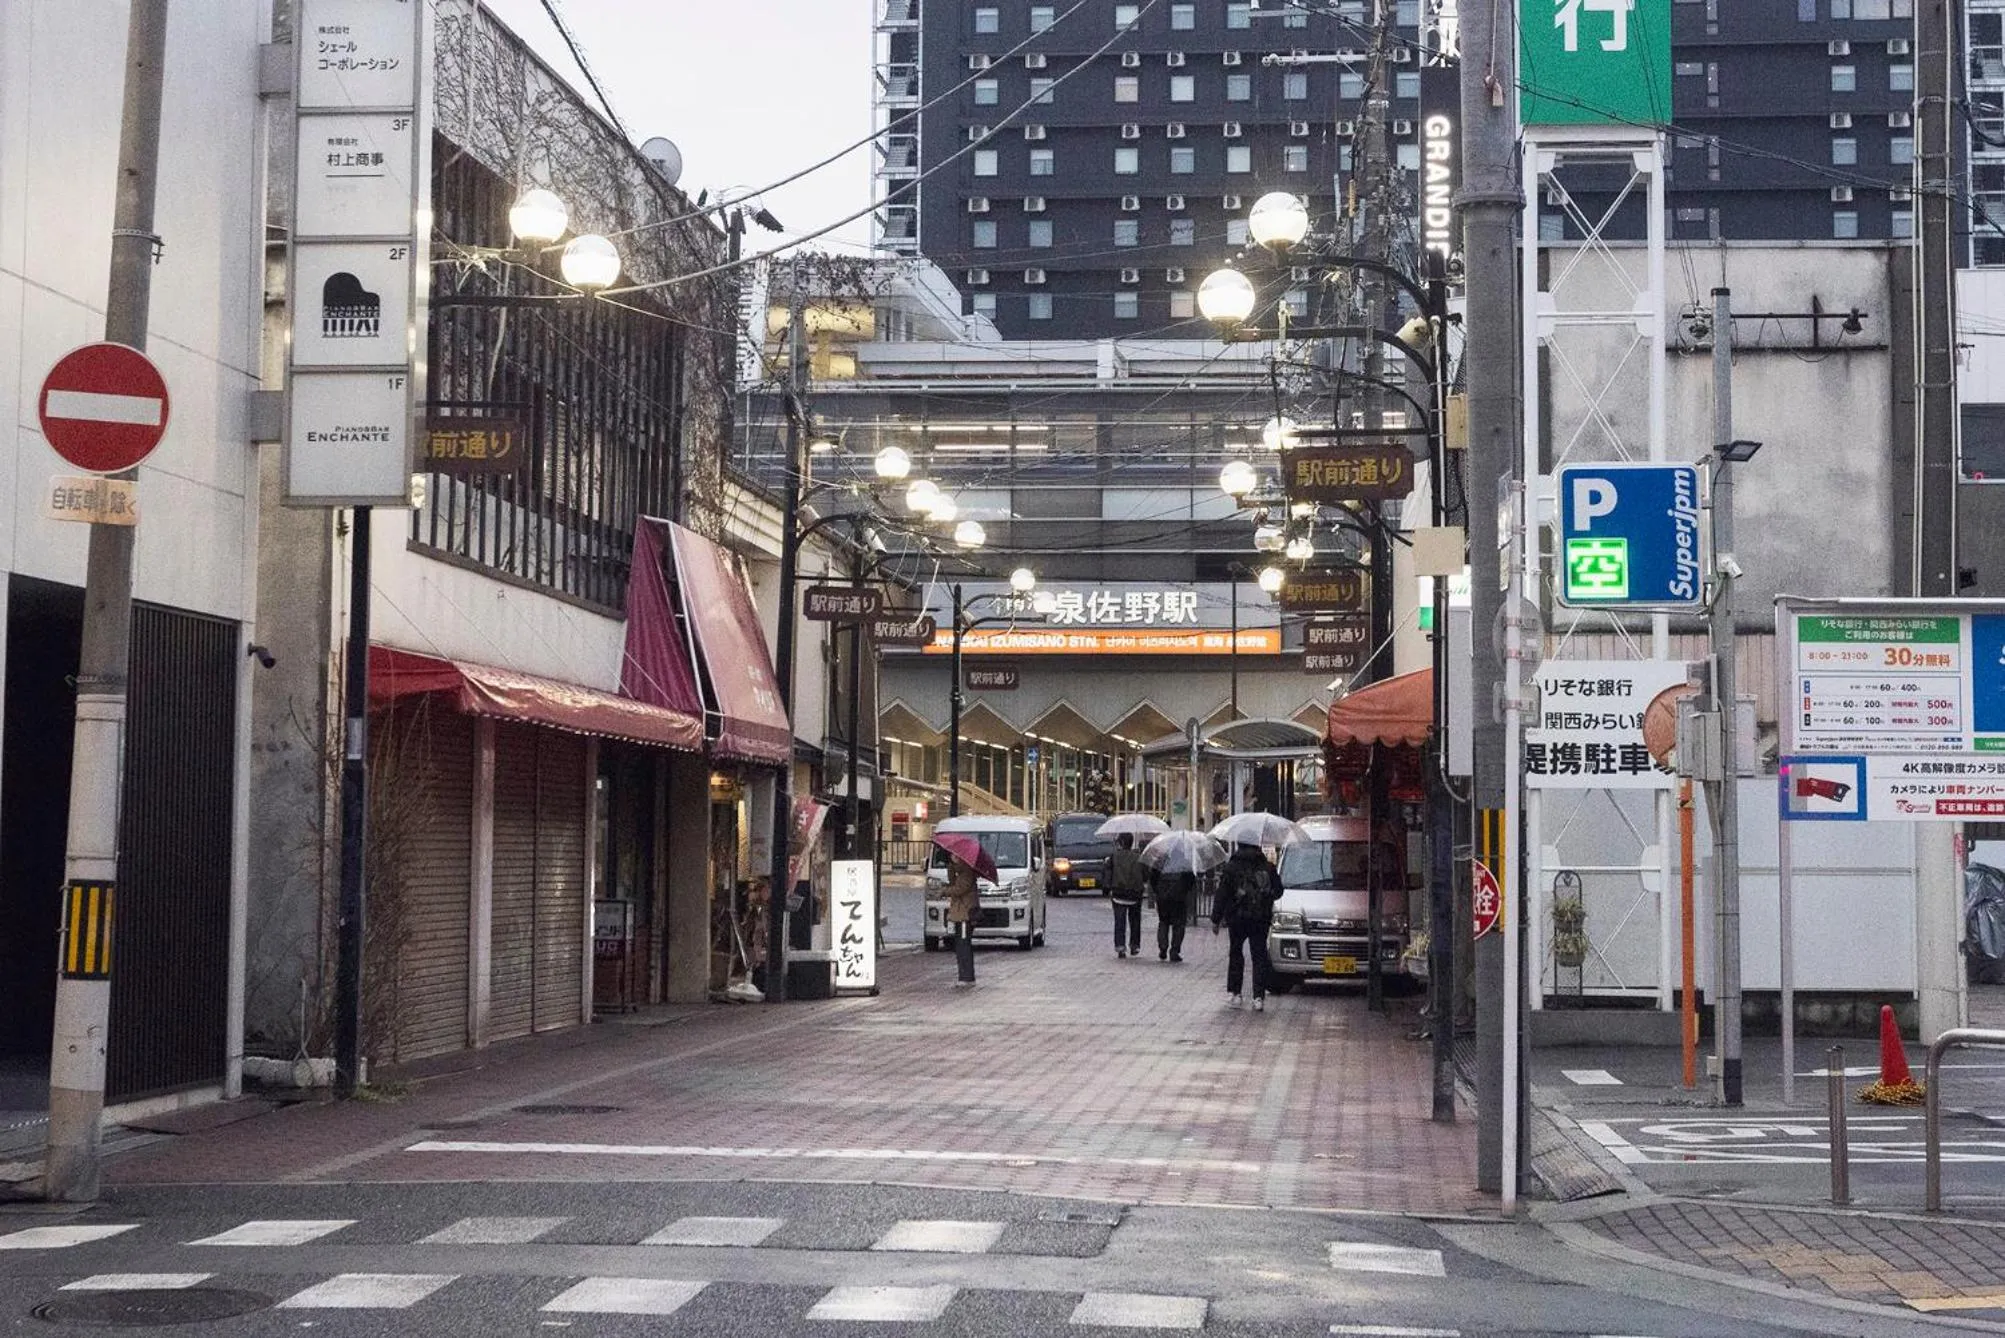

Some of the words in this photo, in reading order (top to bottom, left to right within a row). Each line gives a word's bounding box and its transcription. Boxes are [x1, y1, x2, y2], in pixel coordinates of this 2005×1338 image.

[318, 41, 357, 53] シェール
[318, 57, 399, 70] コーポレーション
[392, 119, 410, 131] 3F
[327, 153, 384, 167] 村上商事
[389, 248, 407, 260] 2F
[388, 378, 405, 390] 1F
[427, 431, 512, 459] 前通り
[1296, 457, 1402, 486] 駅前通り
[1573, 478, 1618, 531] P
[1667, 470, 1698, 599] Superjpm
[1569, 540, 1627, 598] 空
[1286, 584, 1354, 601] 駅前通り
[810, 594, 876, 613] 駅前通り
[1052, 590, 1198, 624] 泉佐野駅
[874, 622, 930, 638] 駅前通り
[1309, 627, 1366, 643] 駅前通り
[1305, 655, 1354, 668] 駅前通り
[970, 672, 1015, 685] 駅前通り
[1545, 679, 1633, 696] りそな銀行
